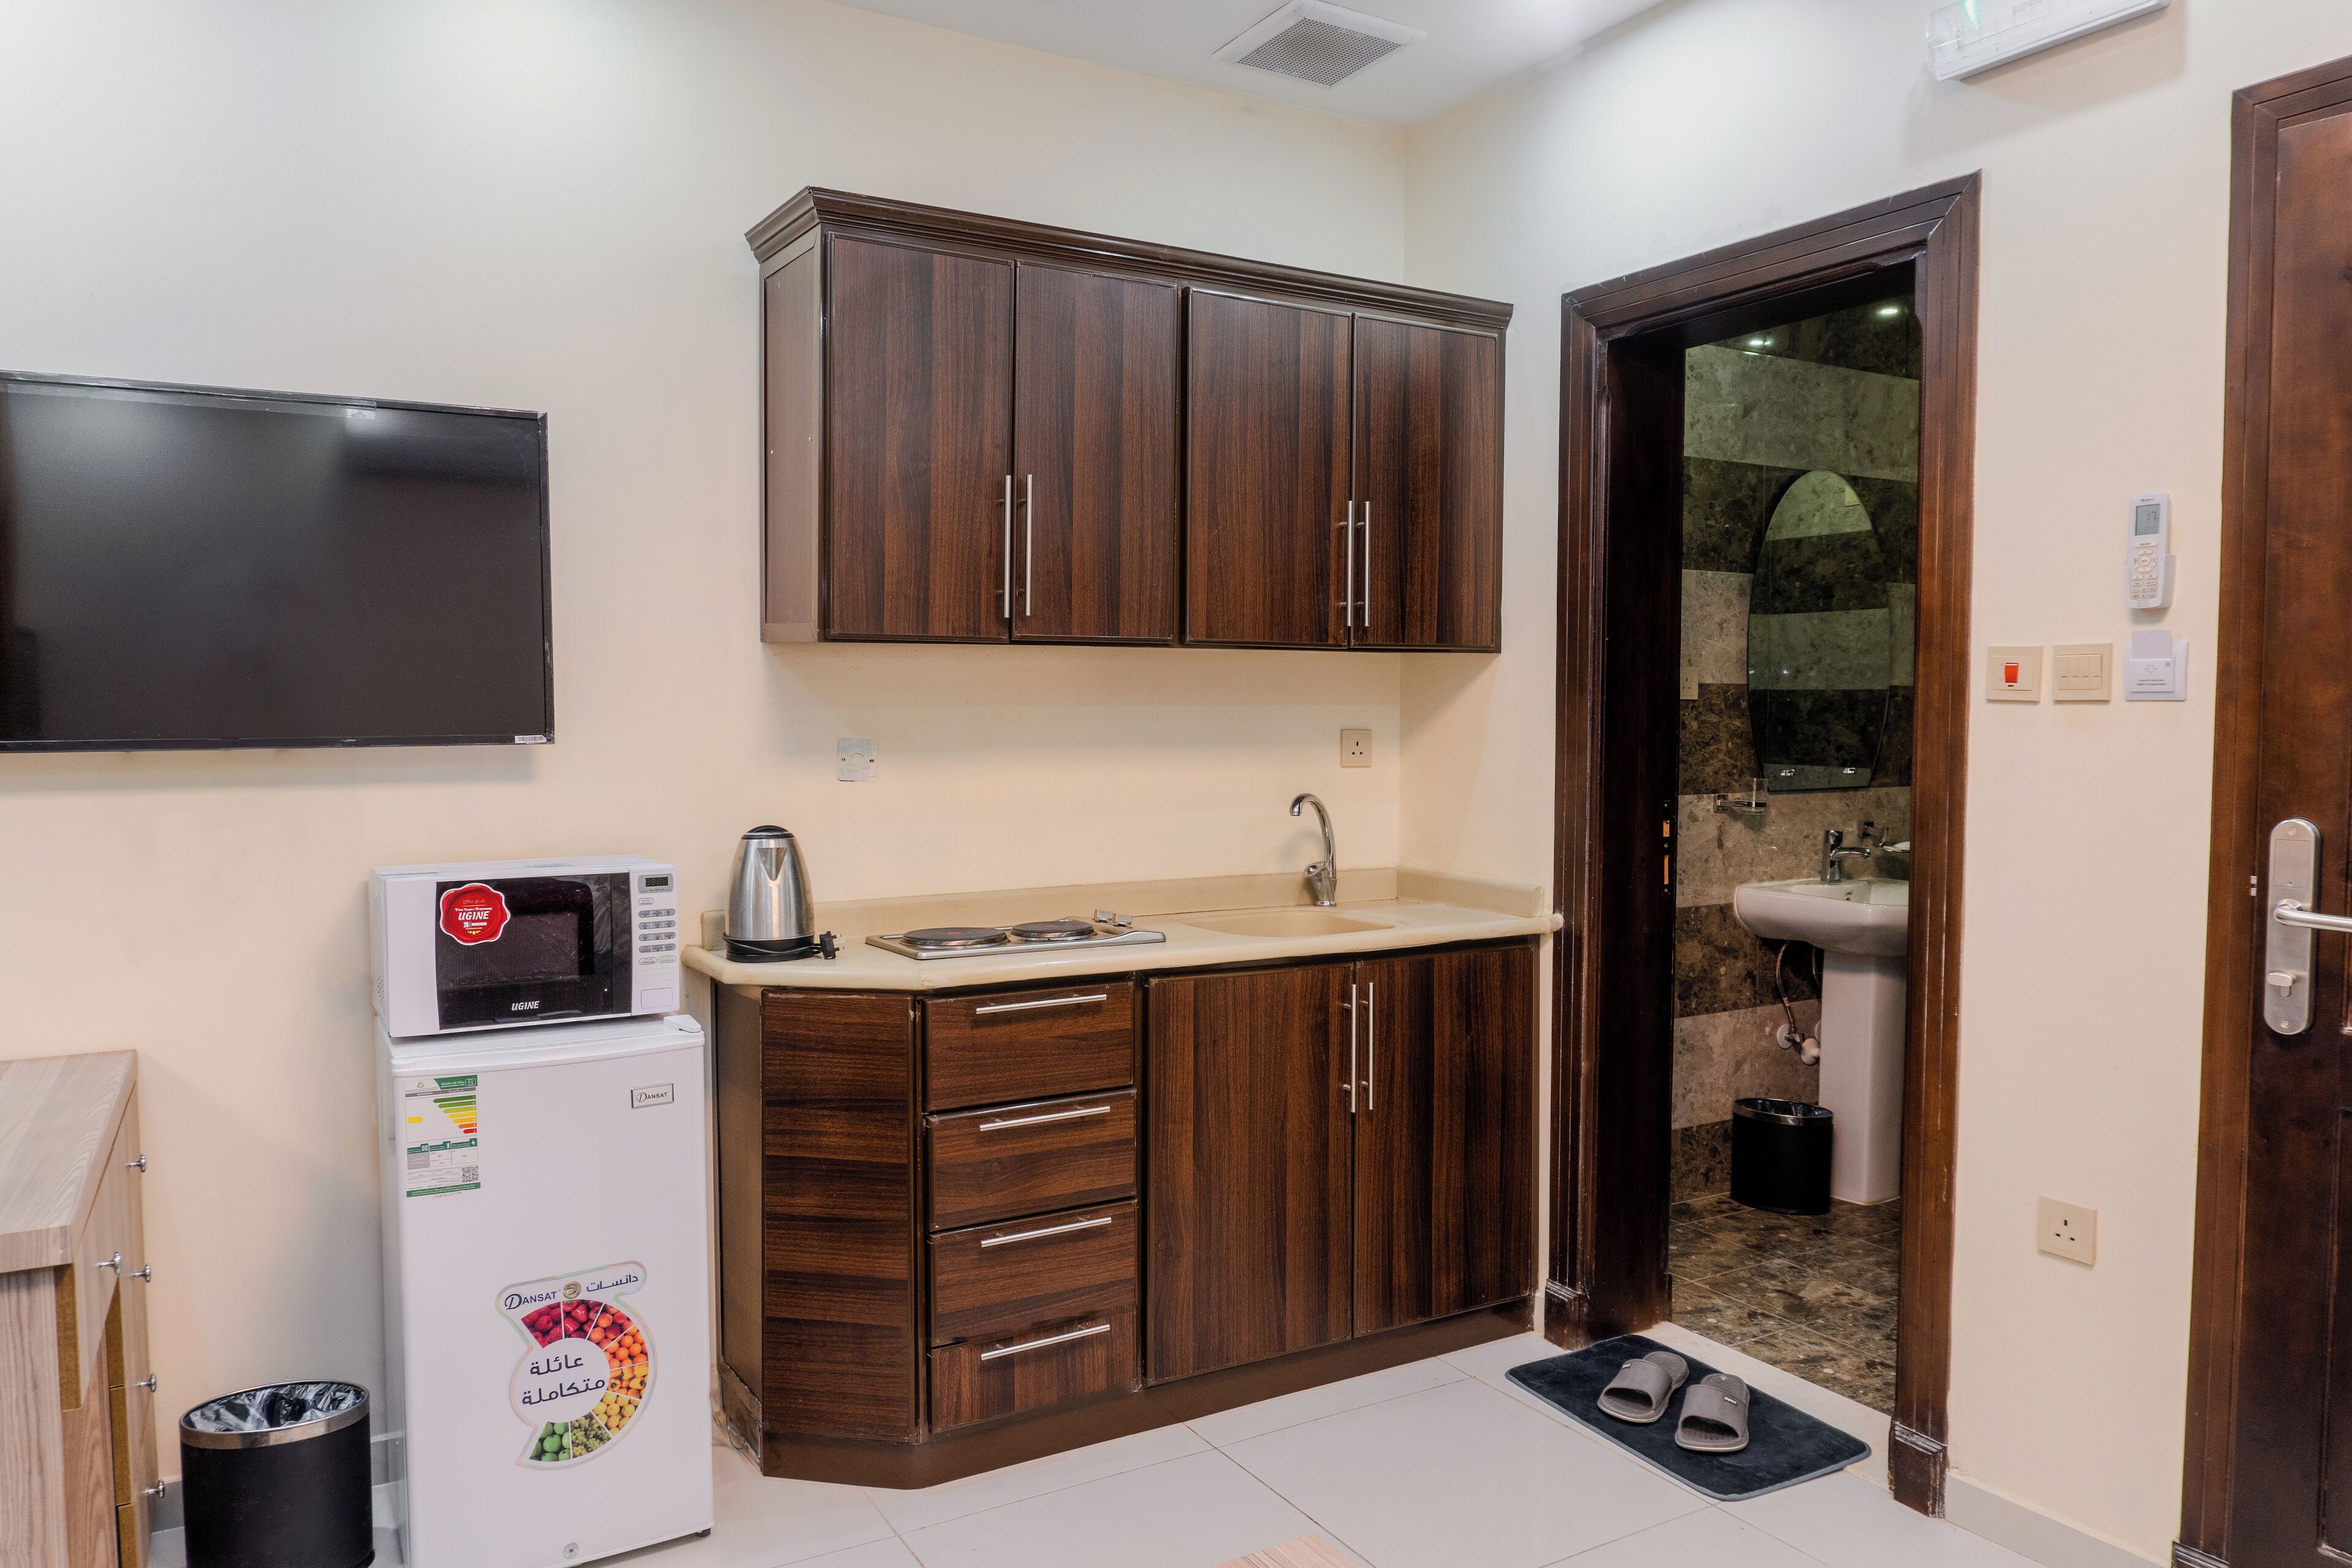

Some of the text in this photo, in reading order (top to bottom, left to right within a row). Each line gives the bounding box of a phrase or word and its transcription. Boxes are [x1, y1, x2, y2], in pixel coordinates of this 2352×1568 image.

[458, 911, 490, 921] UGINE
[511, 1001, 540, 1011] UGINE
[587, 1275, 638, 1292] دانسات
[530, 1354, 584, 1376] عائلة
[522, 1378, 605, 1405] متكاملة
